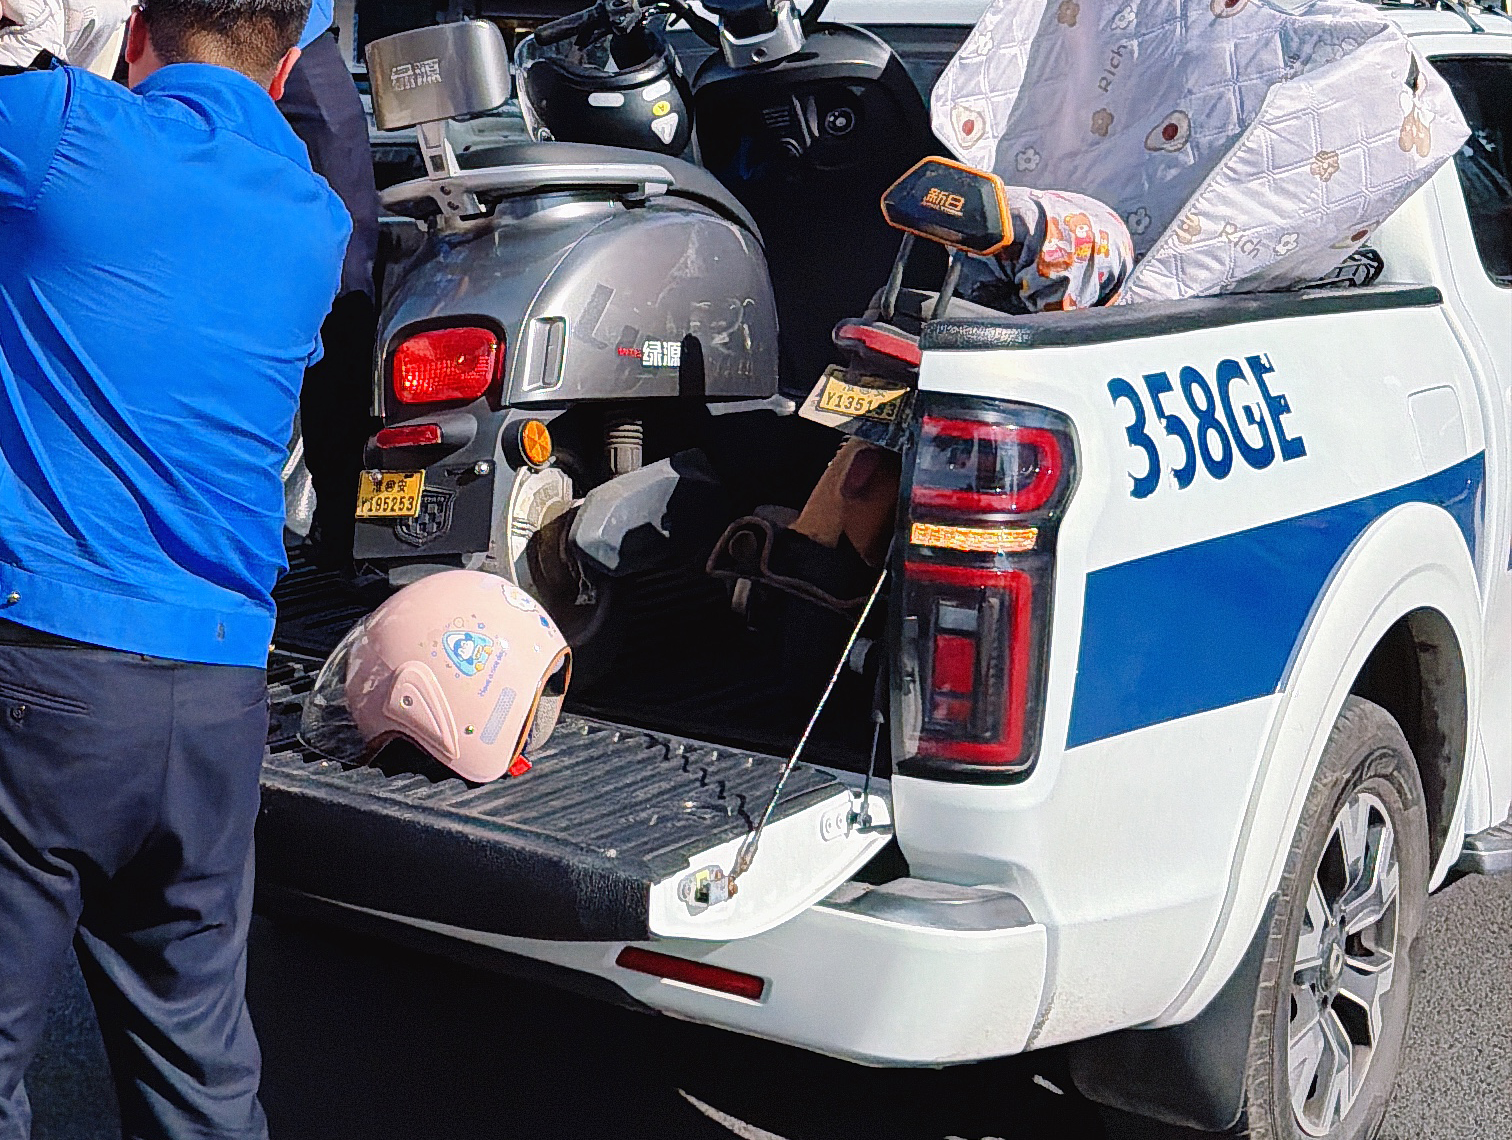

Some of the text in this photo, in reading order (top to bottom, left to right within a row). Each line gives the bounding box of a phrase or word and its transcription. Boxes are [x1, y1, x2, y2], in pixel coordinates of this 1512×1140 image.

[924, 187, 965, 211] 新日
[1218, 221, 1263, 260] Rich
[642, 340, 682, 367] 绿源
[1107, 353, 1307, 500] 358GE
